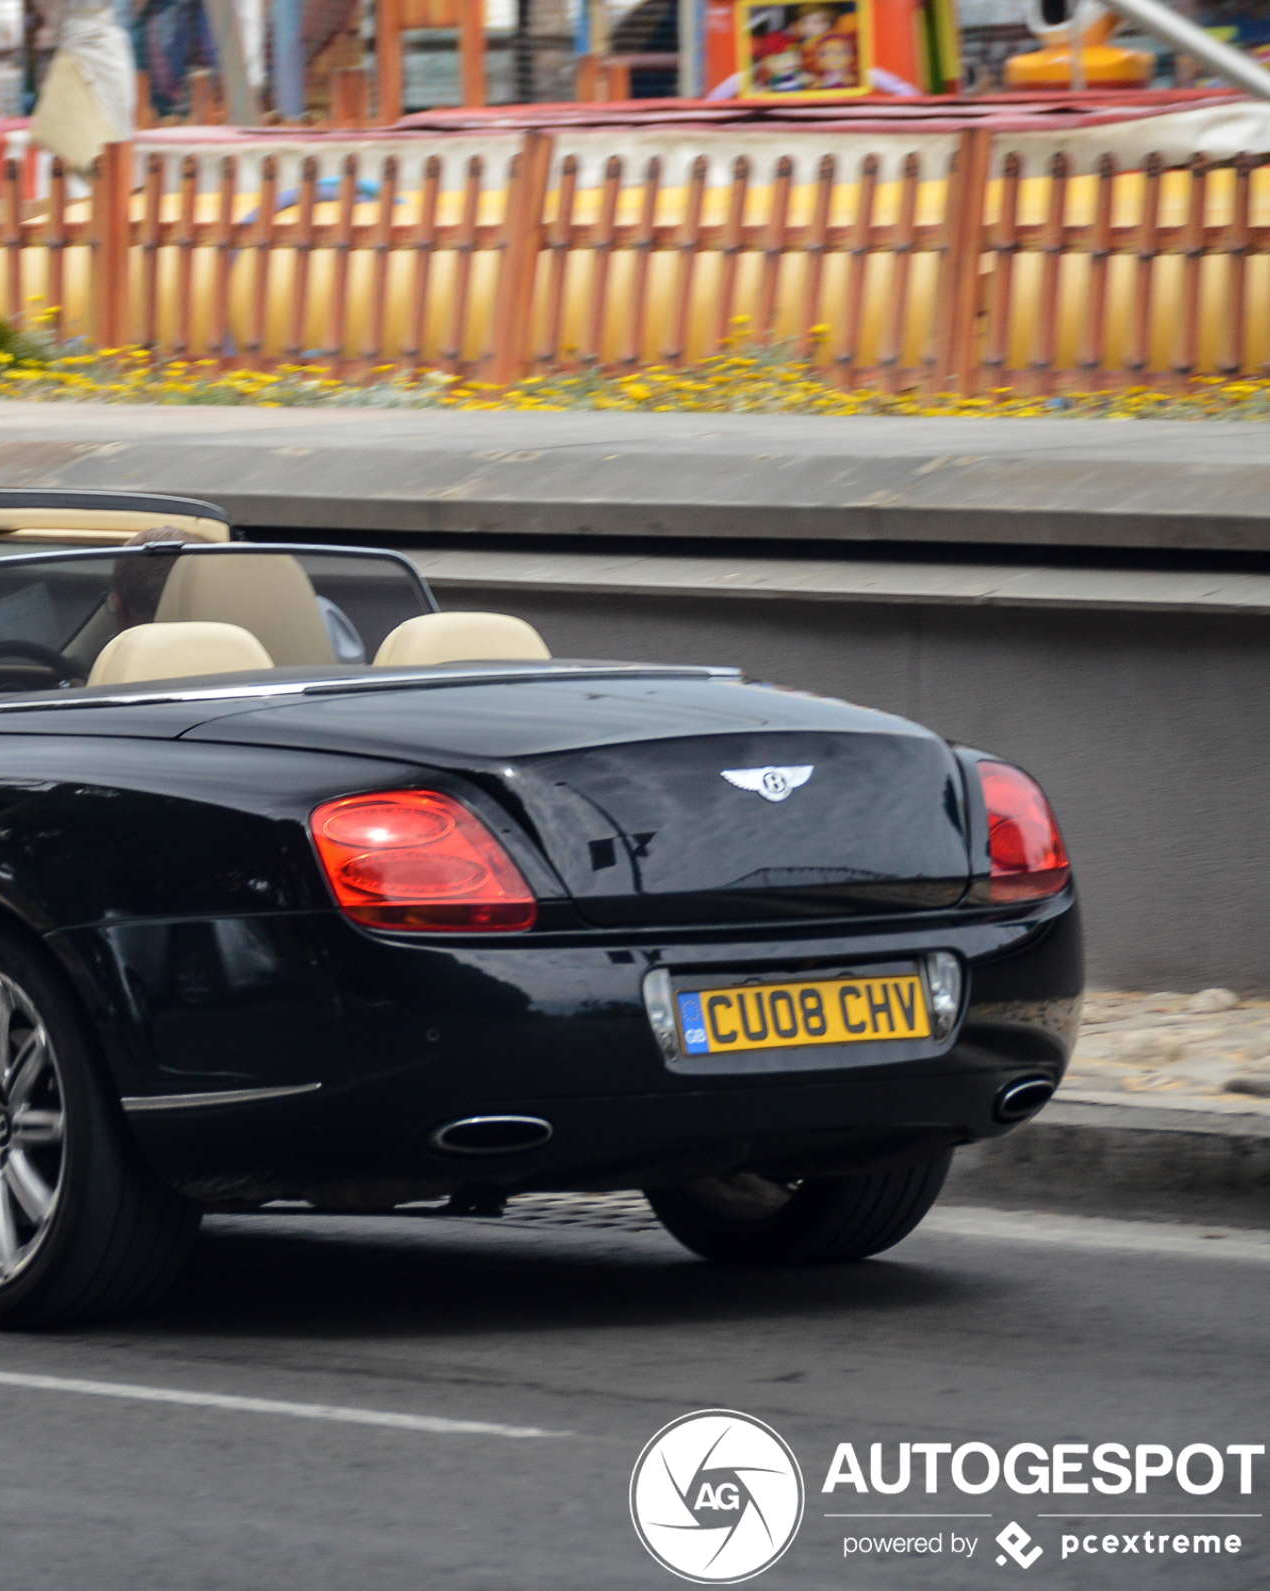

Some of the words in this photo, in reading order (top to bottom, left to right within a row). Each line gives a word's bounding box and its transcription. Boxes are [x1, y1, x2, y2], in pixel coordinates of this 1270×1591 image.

[707, 988, 828, 1044] CU08
[838, 982, 916, 1034] CHV
[685, 1029, 707, 1045] GB
